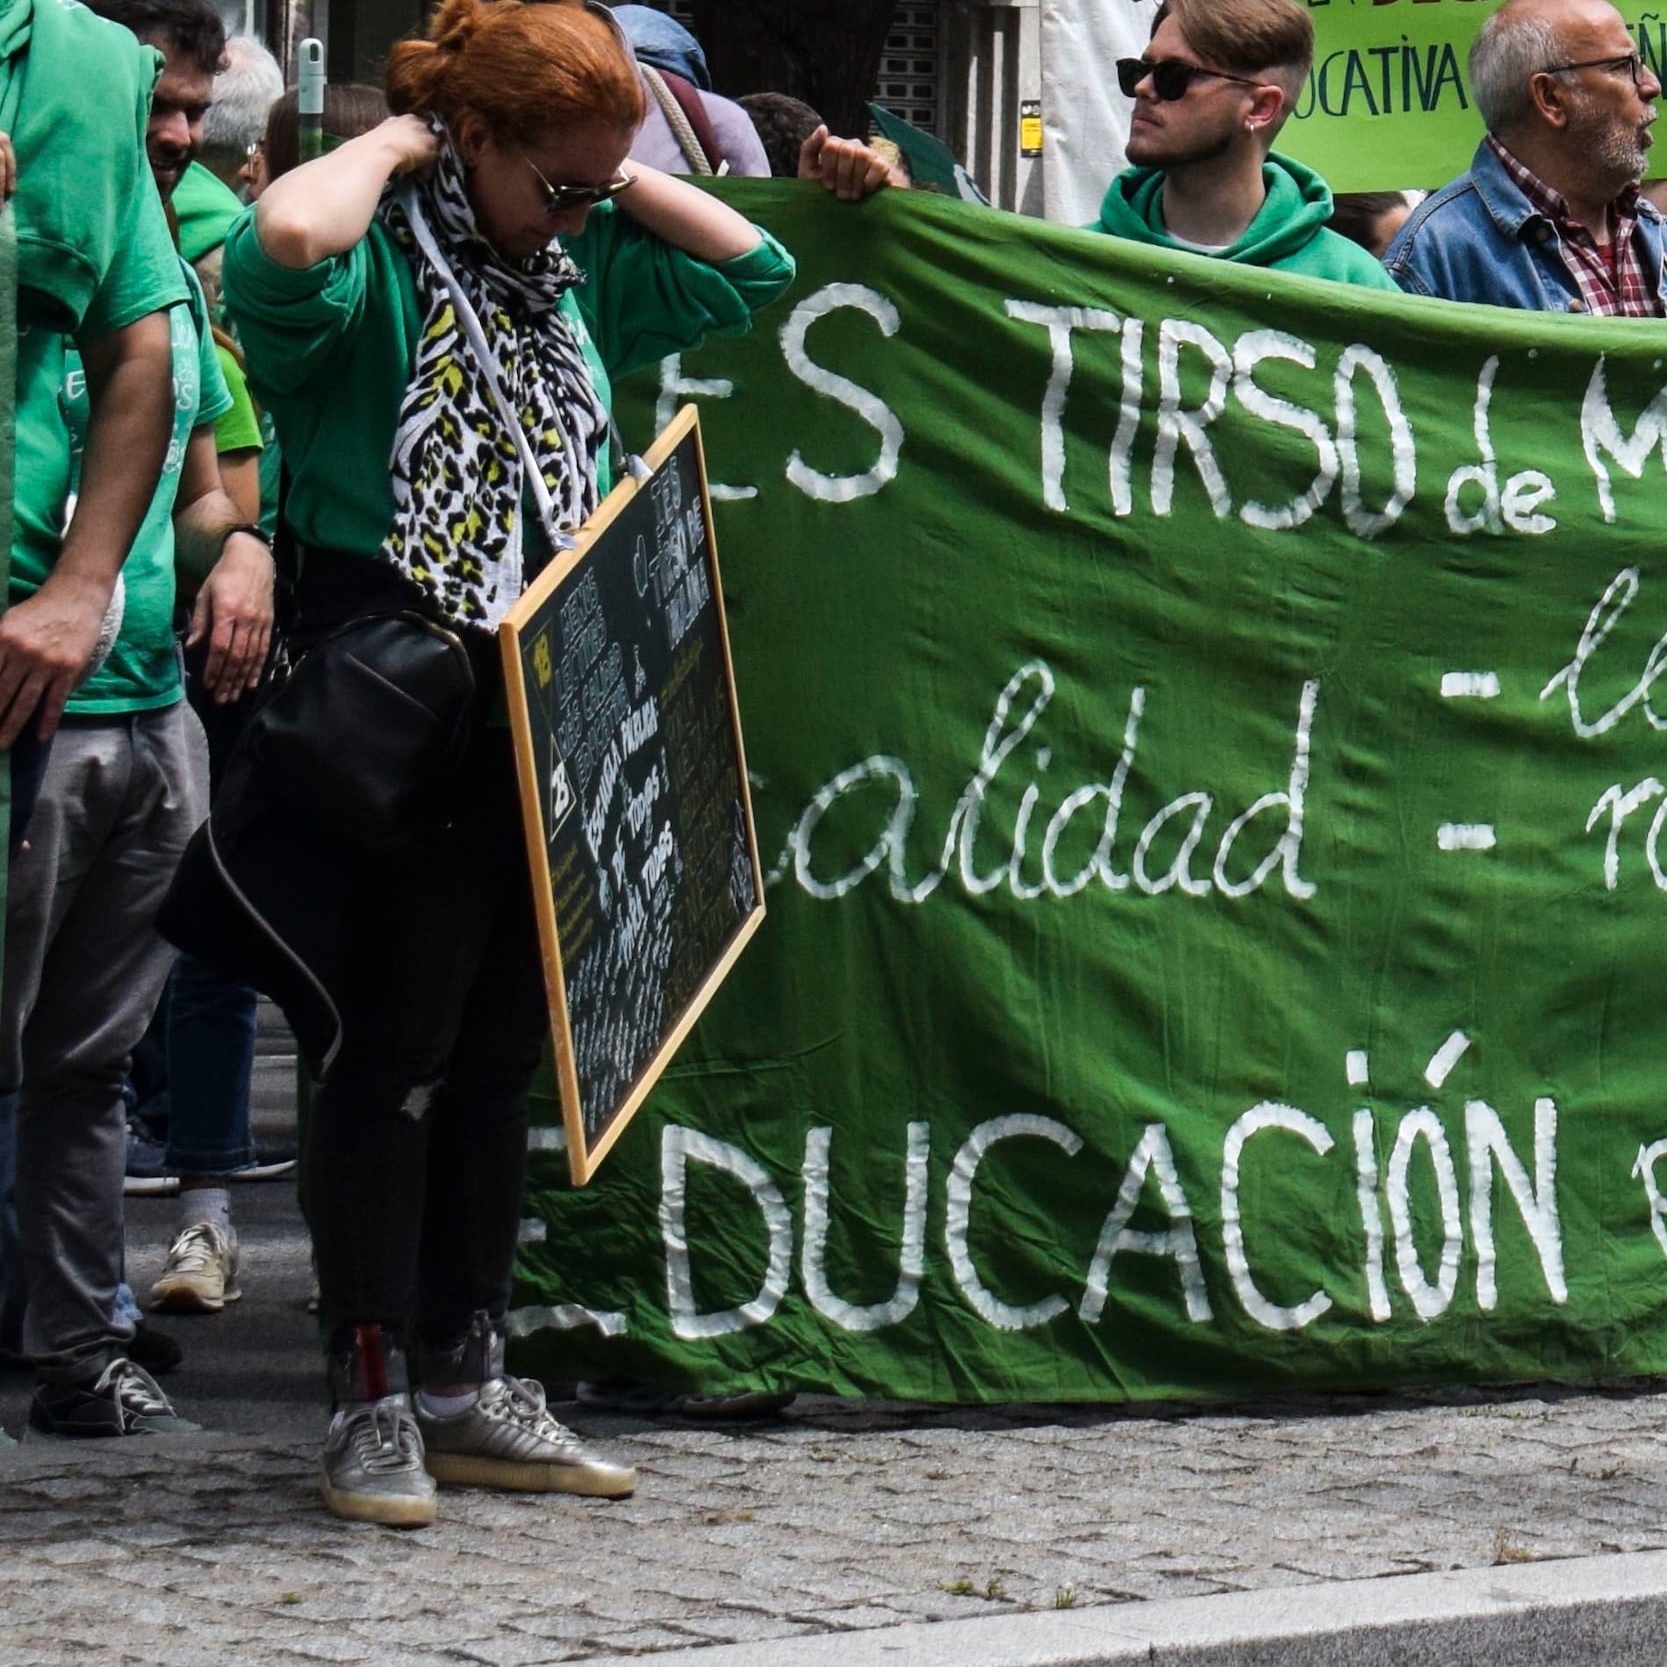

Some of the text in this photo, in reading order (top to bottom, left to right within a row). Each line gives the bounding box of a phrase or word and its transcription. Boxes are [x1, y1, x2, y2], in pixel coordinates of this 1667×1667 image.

[1004, 298, 1419, 537] TIRSO
[1443, 353, 1557, 535] de
[768, 659, 1316, 905] alidad
